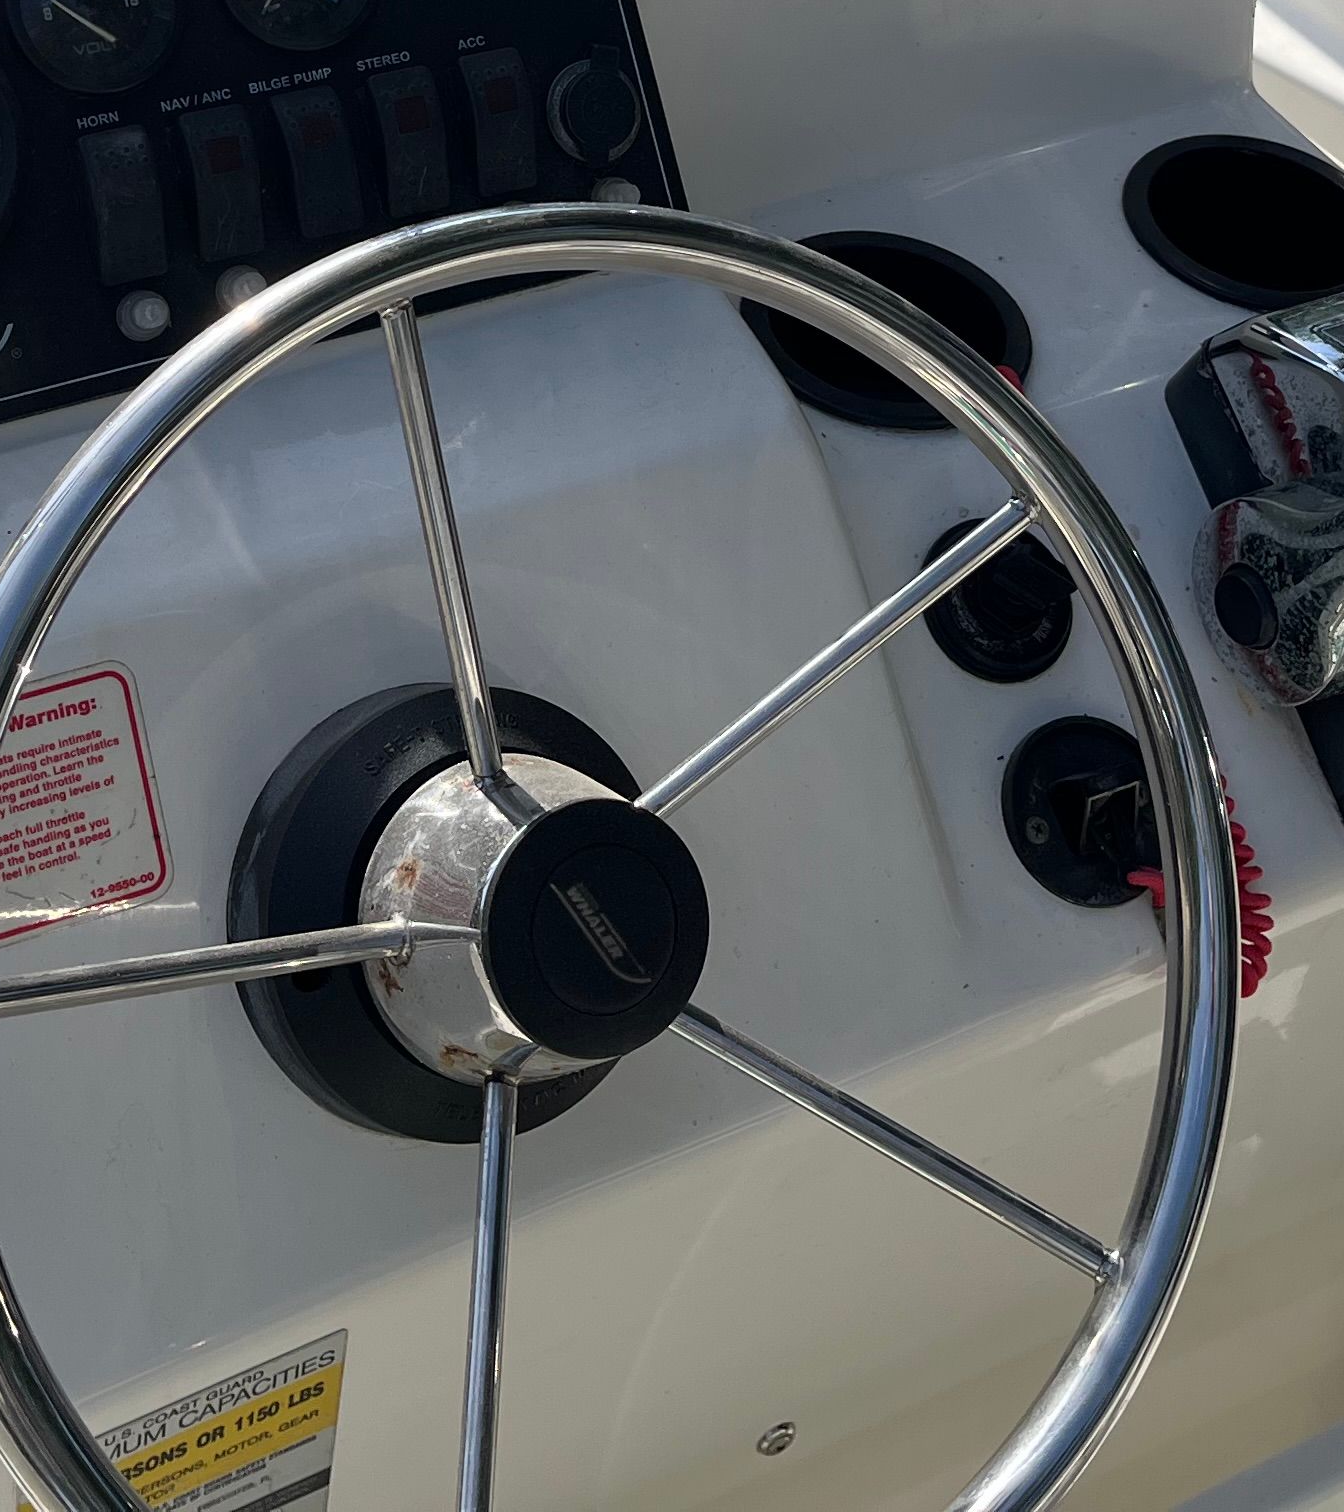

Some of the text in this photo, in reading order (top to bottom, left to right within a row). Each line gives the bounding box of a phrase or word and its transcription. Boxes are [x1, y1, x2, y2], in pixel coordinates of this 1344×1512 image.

[42, 6, 54, 22] 8
[457, 35, 486, 50] ACC
[356, 50, 411, 72] STEREO
[248, 66, 333, 95] BILGE PUMP
[160, 94, 192, 114] NAV
[200, 88, 232, 105] ANC
[76, 110, 120, 130] HORN
[8, 697, 97, 733] Warning:
[17, 744, 56, 760] require
[58, 729, 102, 749] intimate
[40, 737, 120, 766] characteristics
[53, 760, 84, 775] Learn
[87, 754, 104, 767] the
[9, 790, 66, 814] increasing
[69, 781, 101, 796] levels
[103, 775, 115, 786] of
[20, 783, 41, 798] and
[42, 773, 82, 791] throttle
[23, 827, 71, 850] handling
[74, 823, 87, 834] as
[89, 817, 110, 831] you
[26, 821, 43, 835] full
[46, 810, 86, 828] throttle
[7, 853, 25, 867] the
[28, 846, 54, 861] boat
[56, 841, 67, 852] at
[69, 838, 76, 848] a
[78, 828, 112, 847] speed
[2, 867, 23, 881] feel
[25, 863, 37, 875] in
[38, 851, 81, 871] control.
[566, 886, 625, 961] WHALER
[178, 1349, 336, 1429] CAPACITIES
[104, 1370, 265, 1447] U.S. COAST GUARD
[196, 1425, 226, 1448] OR
[234, 1401, 280, 1432] 1150
[287, 1381, 325, 1409] LBS
[213, 1430, 273, 1462] MOTOR,
[278, 1408, 320, 1432] GEAR
